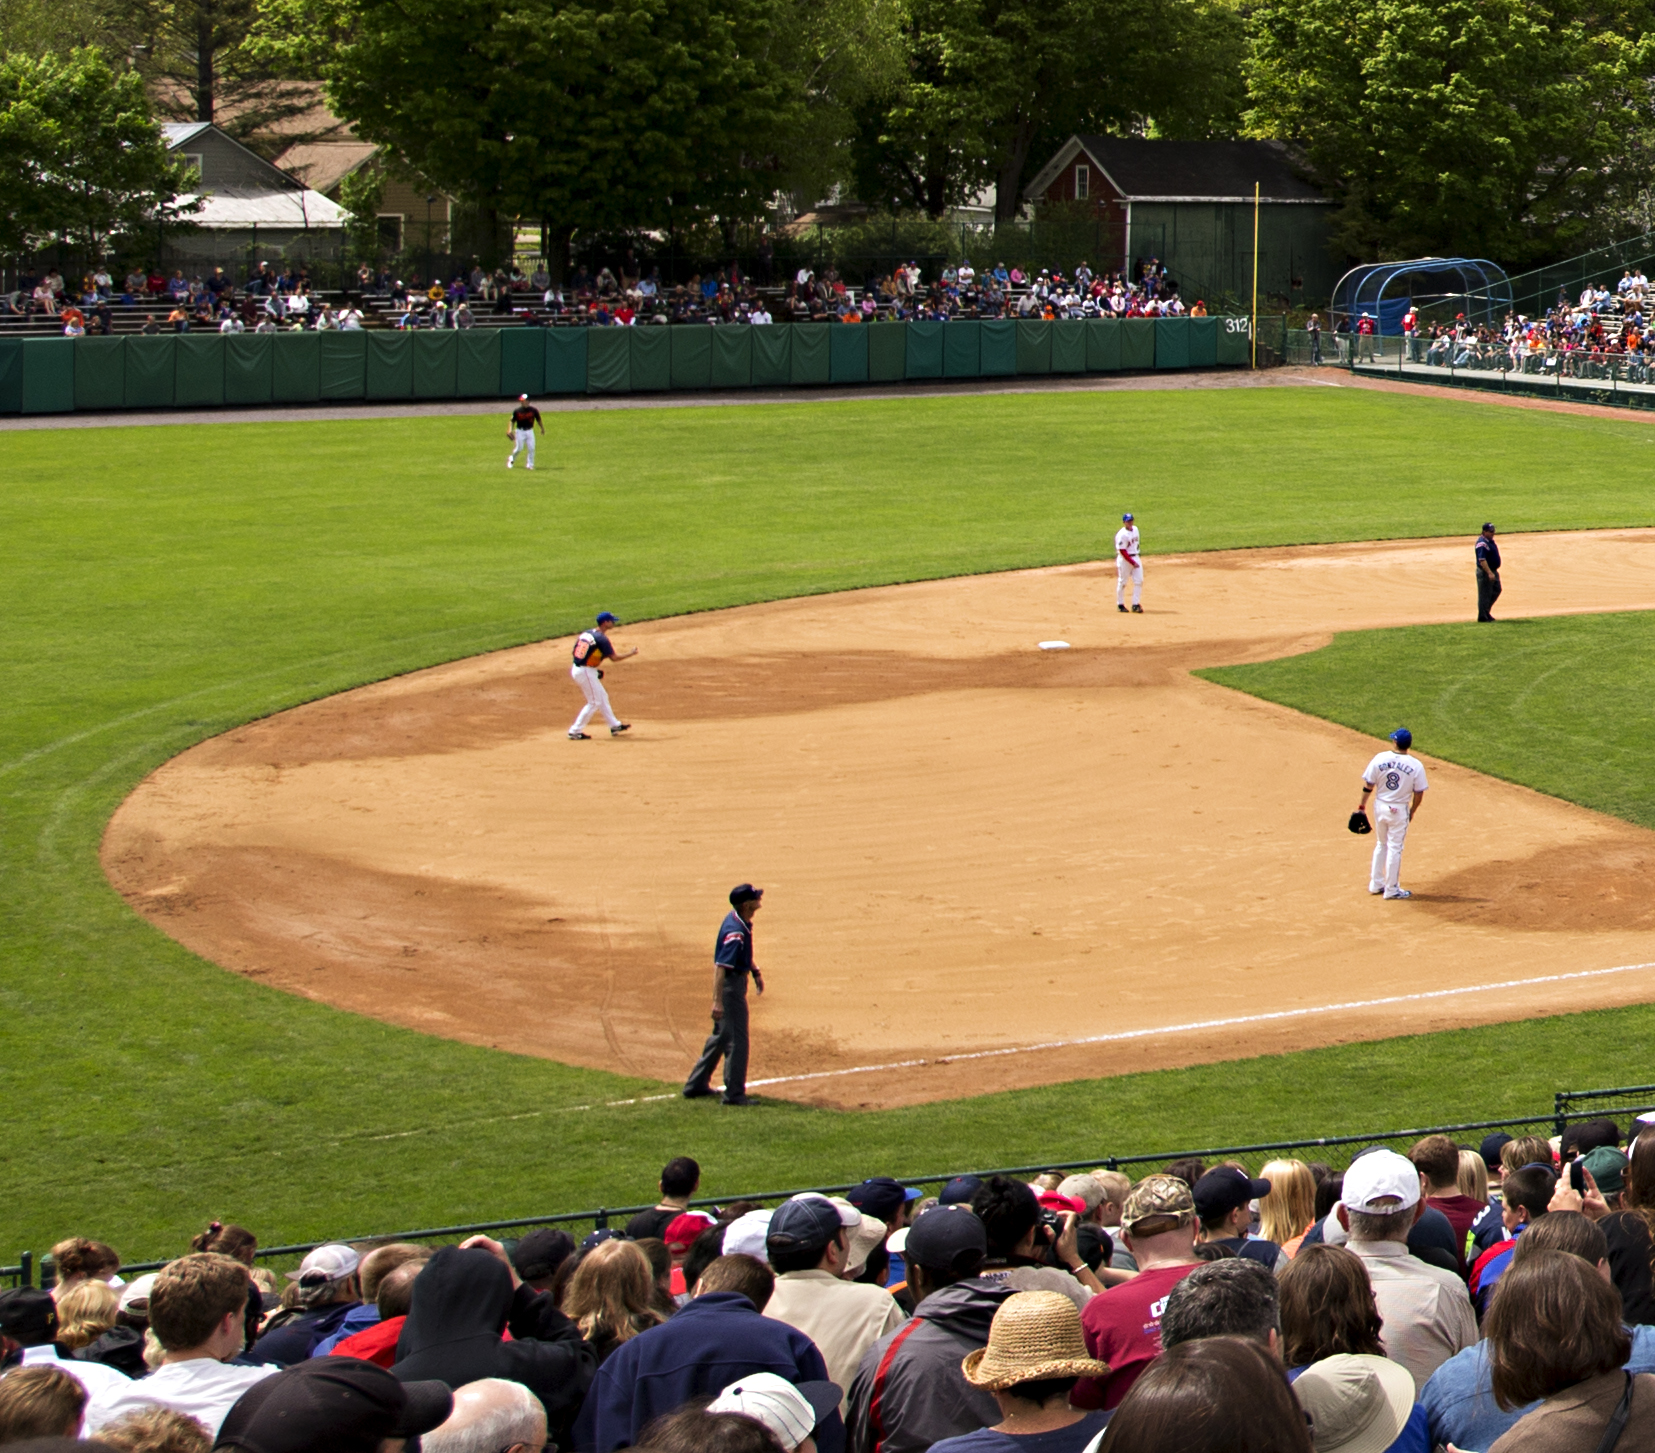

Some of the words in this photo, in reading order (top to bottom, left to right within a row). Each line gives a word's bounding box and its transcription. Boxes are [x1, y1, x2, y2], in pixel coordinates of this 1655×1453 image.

[1225, 318, 1248, 333] 312
[1378, 761, 1414, 775] GONZALEZ
[1386, 772, 1400, 791] 8
